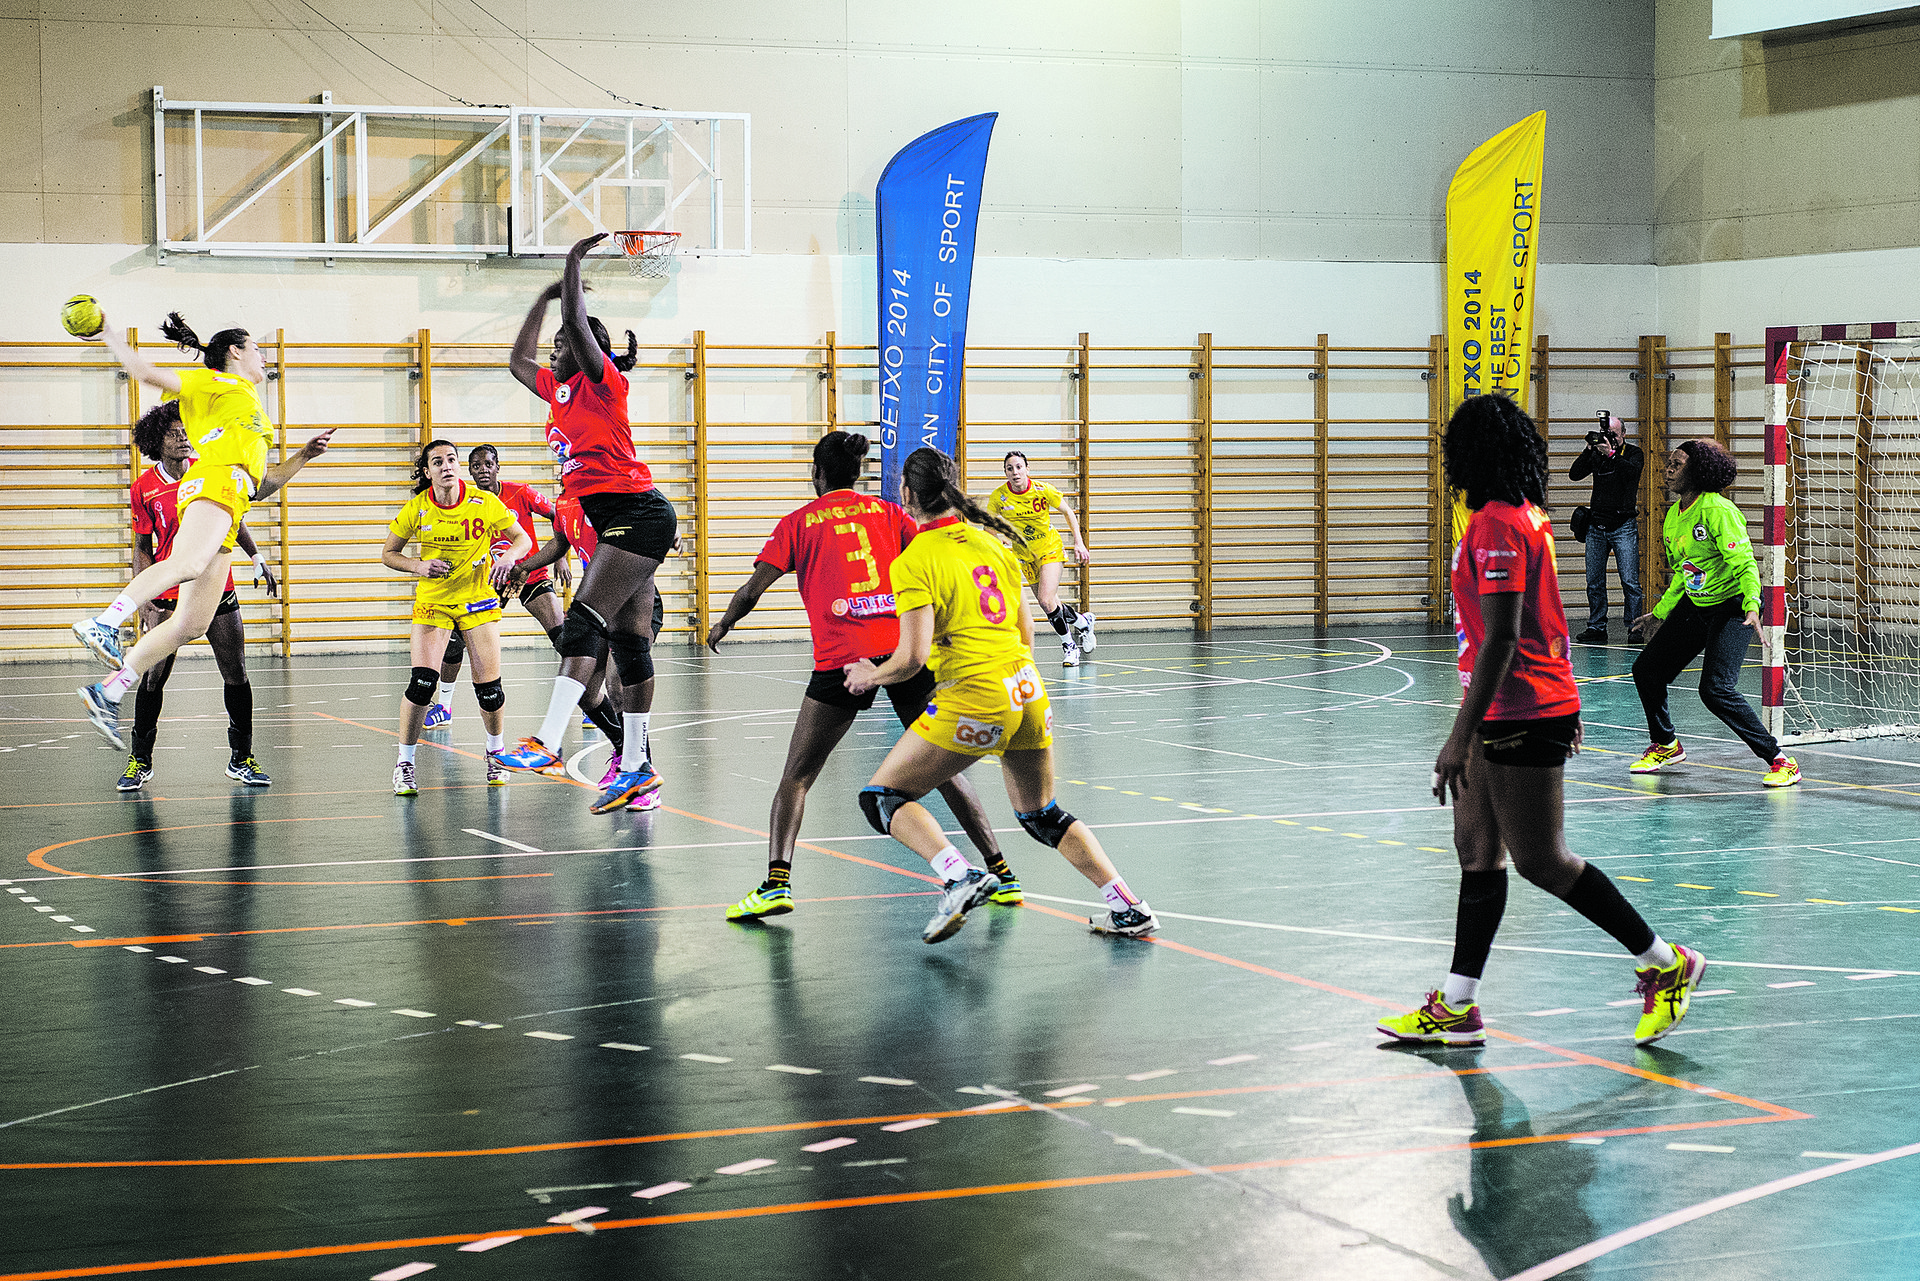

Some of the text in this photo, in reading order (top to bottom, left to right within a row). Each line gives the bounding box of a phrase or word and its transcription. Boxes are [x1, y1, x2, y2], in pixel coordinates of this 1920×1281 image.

[938, 173, 965, 263] SPORT
[1513, 178, 1534, 267] SPORT
[933, 281, 952, 317] OF
[1463, 270, 1482, 330] 2014
[1513, 277, 1524, 312] OF
[881, 268, 911, 449] GETXO 2014
[926, 335, 946, 394] CITY
[1490, 305, 1506, 393] HE BEST
[1506, 322, 1522, 379] CITY
[460, 518, 485, 540] 18
[805, 502, 885, 528] ANGOLA
[834, 522, 881, 593] 3
[972, 565, 1007, 624] 8
[956, 724, 993, 745] GO
